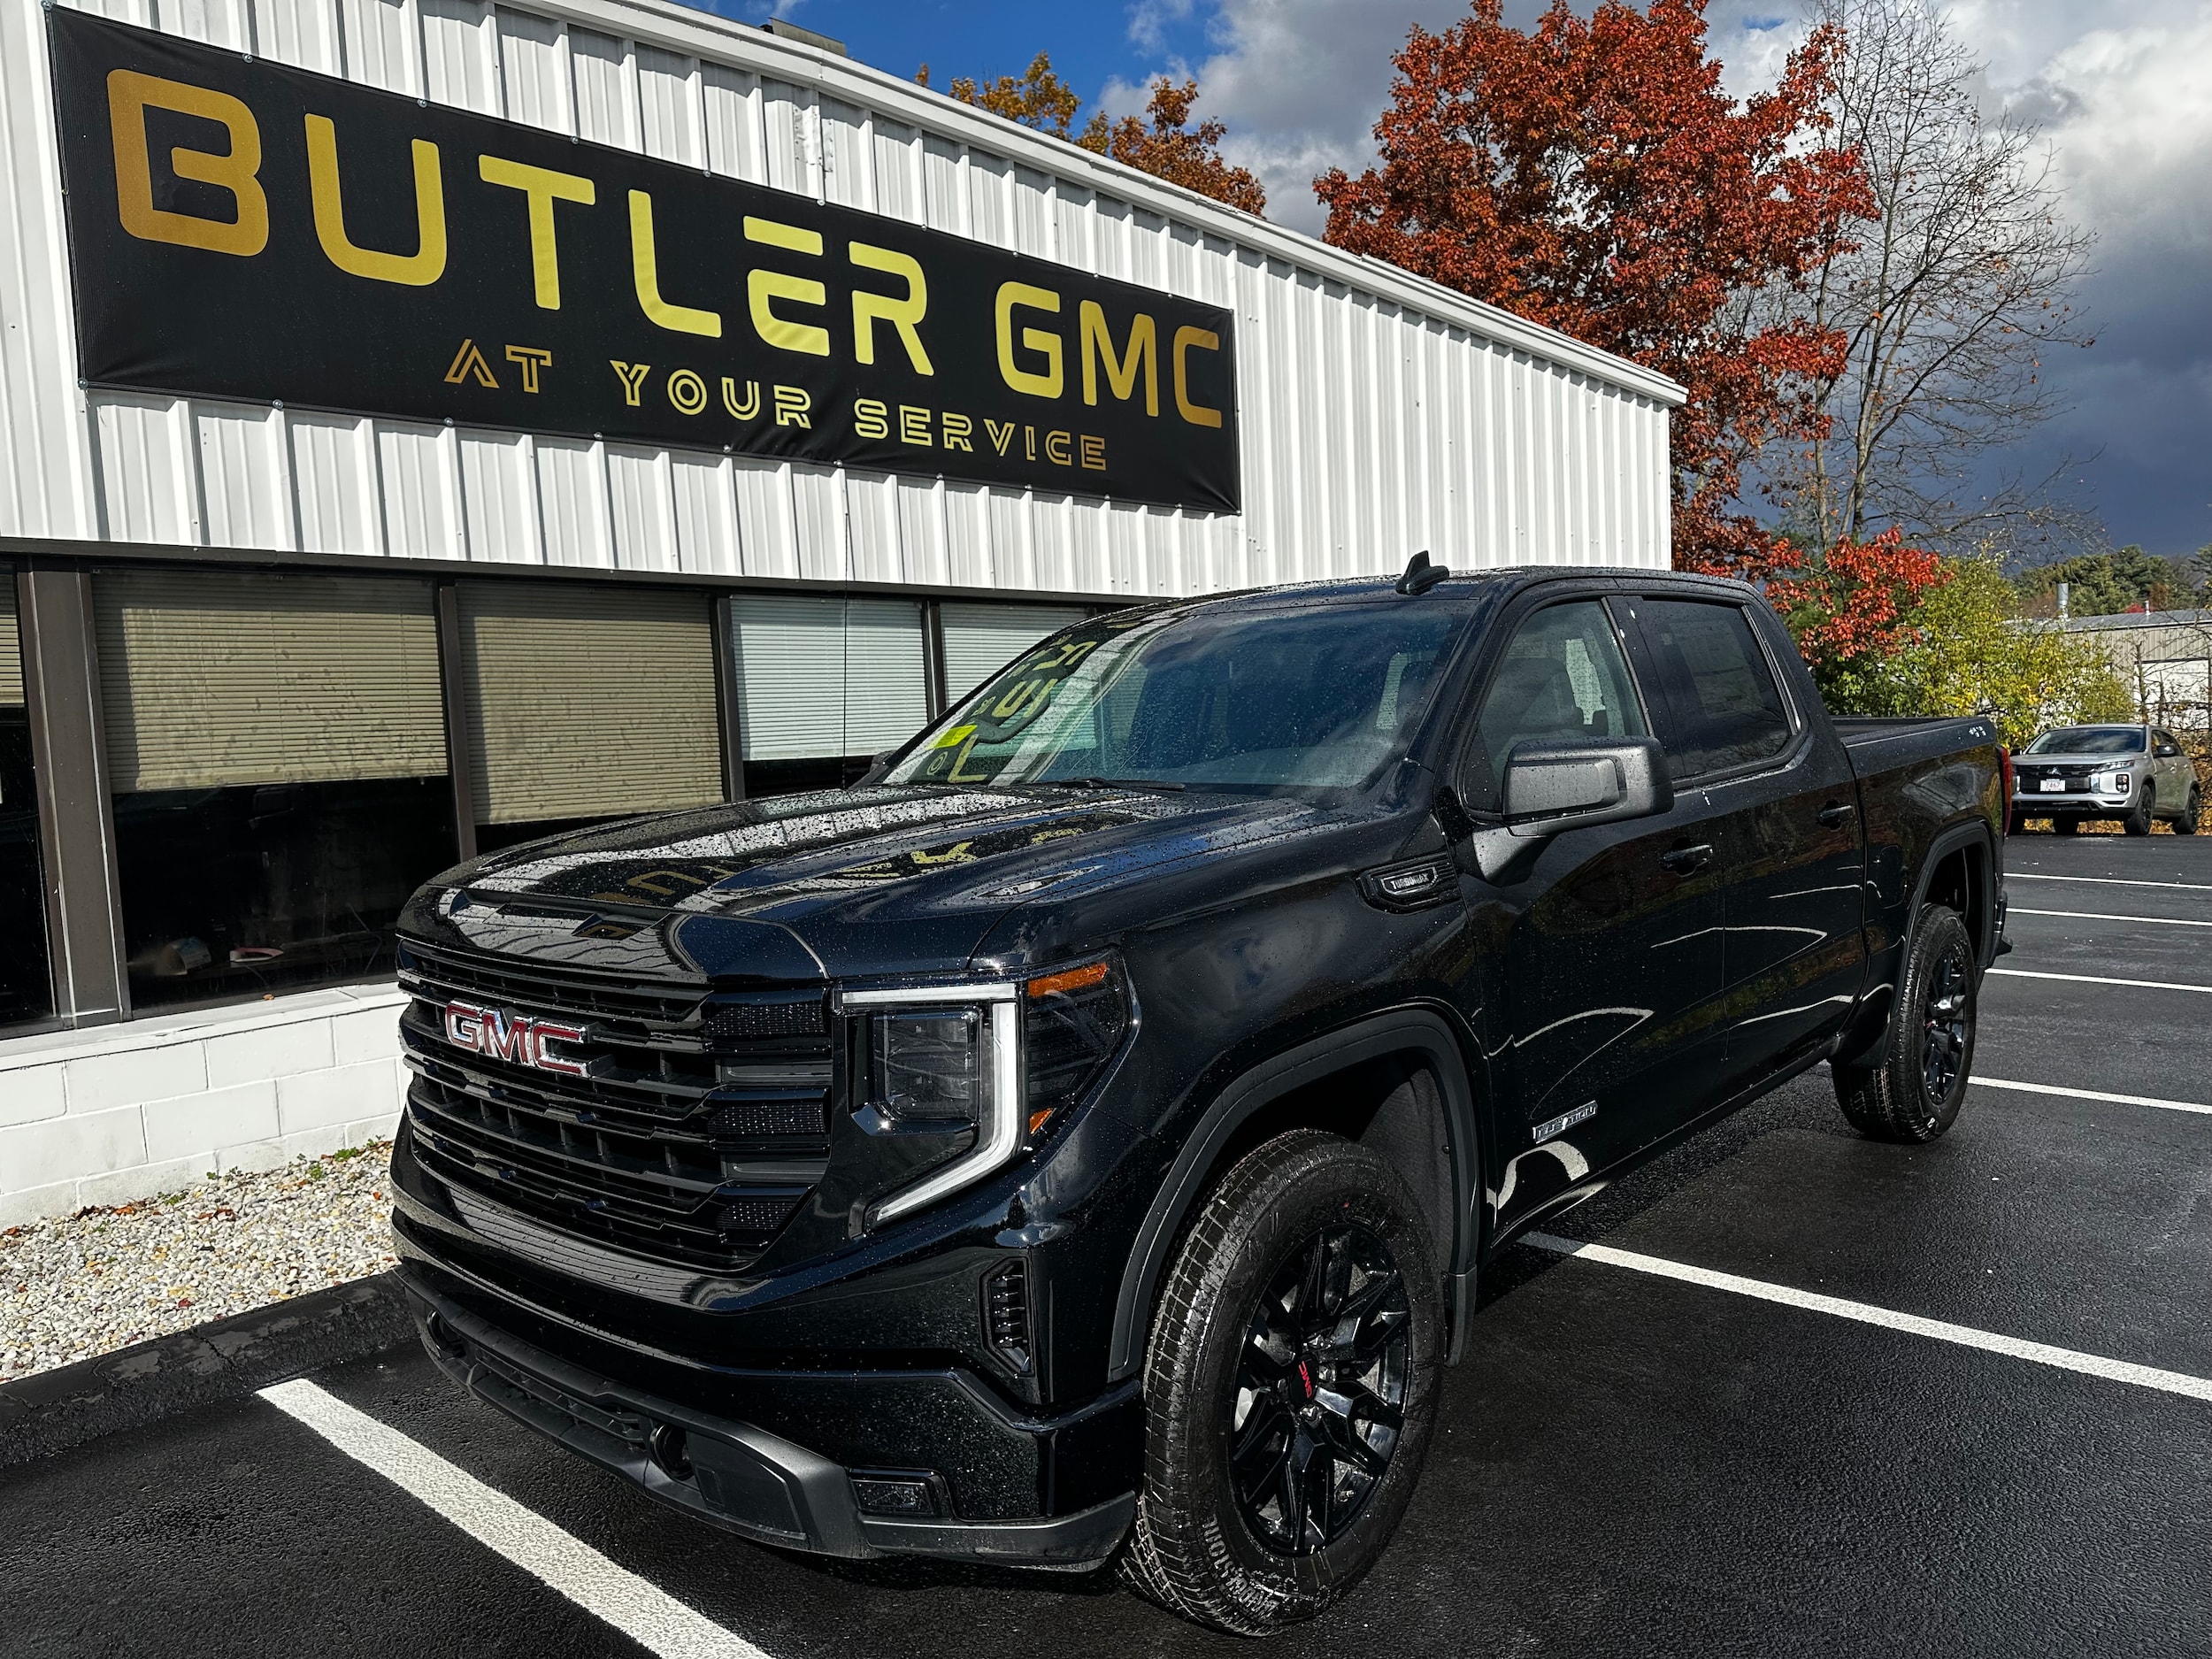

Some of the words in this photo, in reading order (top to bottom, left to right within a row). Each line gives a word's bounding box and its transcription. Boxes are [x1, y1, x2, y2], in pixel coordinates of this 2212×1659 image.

[106, 68, 934, 377] BUTLER
[995, 280, 1223, 428] GMC
[444, 339, 553, 394] AT
[611, 360, 811, 429] YOUR
[854, 398, 1107, 471] SERVICE
[445, 1000, 590, 1078] GMC
[1298, 1360, 1312, 1398] GMC
